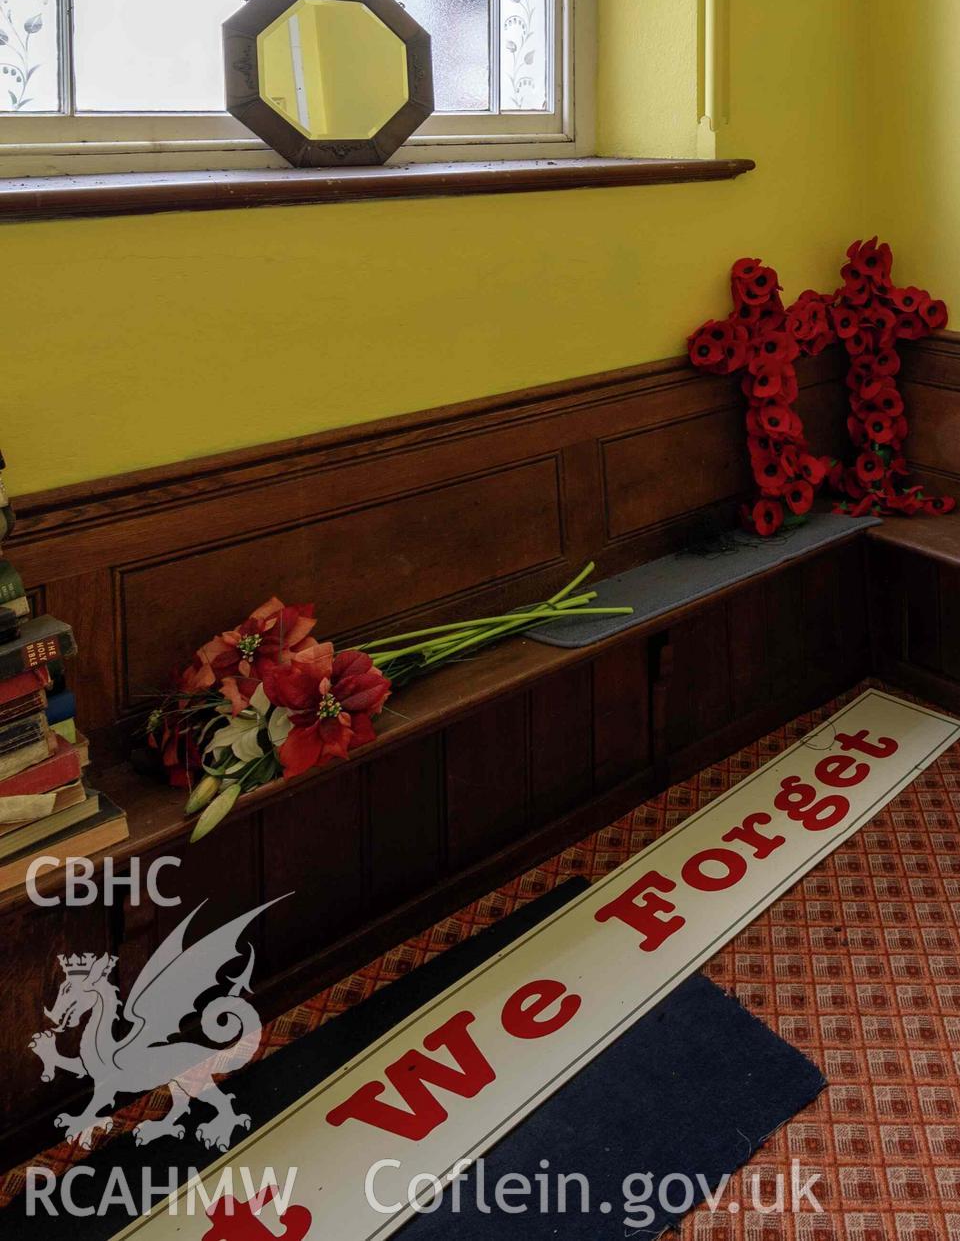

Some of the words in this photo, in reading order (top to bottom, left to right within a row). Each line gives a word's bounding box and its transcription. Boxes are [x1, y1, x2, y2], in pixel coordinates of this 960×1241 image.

[26, 644, 38, 667] BIBLE
[36, 641, 48, 661] HOLY
[47, 641, 57, 656] THE
[327, 980, 581, 1141] We
[594, 729, 899, 952] Forget
